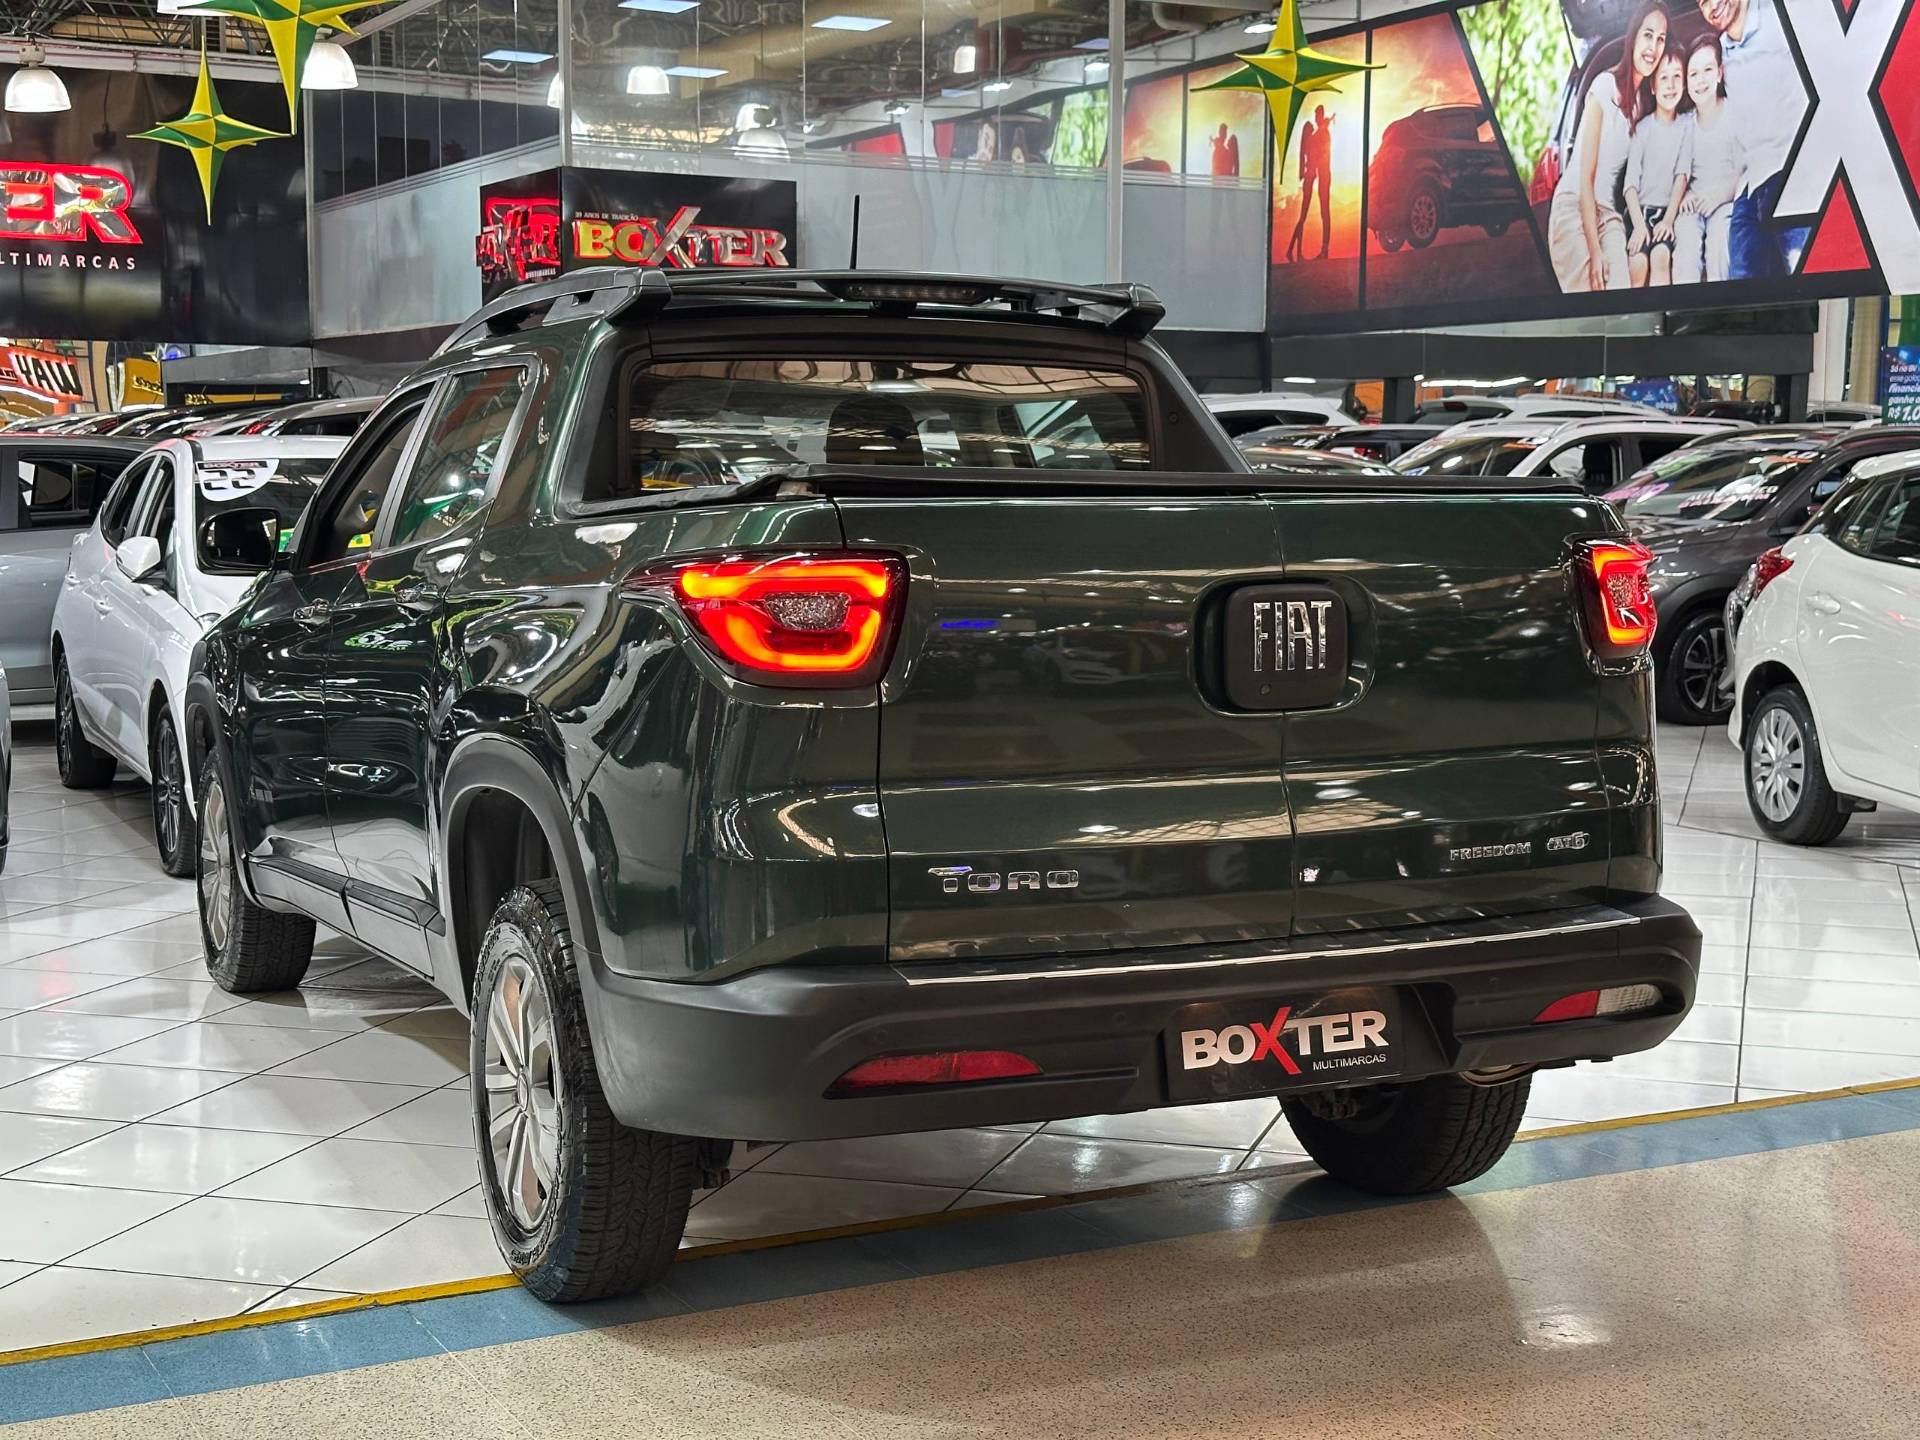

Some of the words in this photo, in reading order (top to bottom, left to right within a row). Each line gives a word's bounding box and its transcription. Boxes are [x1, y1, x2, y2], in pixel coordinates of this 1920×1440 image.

[573, 205, 789, 267] BOXTER
[1888, 395, 1914, 406] ganhe
[1888, 406, 1901, 420] R$
[1253, 600, 1332, 672] FIAT
[1450, 841, 1532, 861] FREEDOM
[927, 865, 1080, 893] TORO
[1181, 1006, 1390, 1075] BOXTER
[1312, 1053, 1387, 1071] MULTIMARCAS
